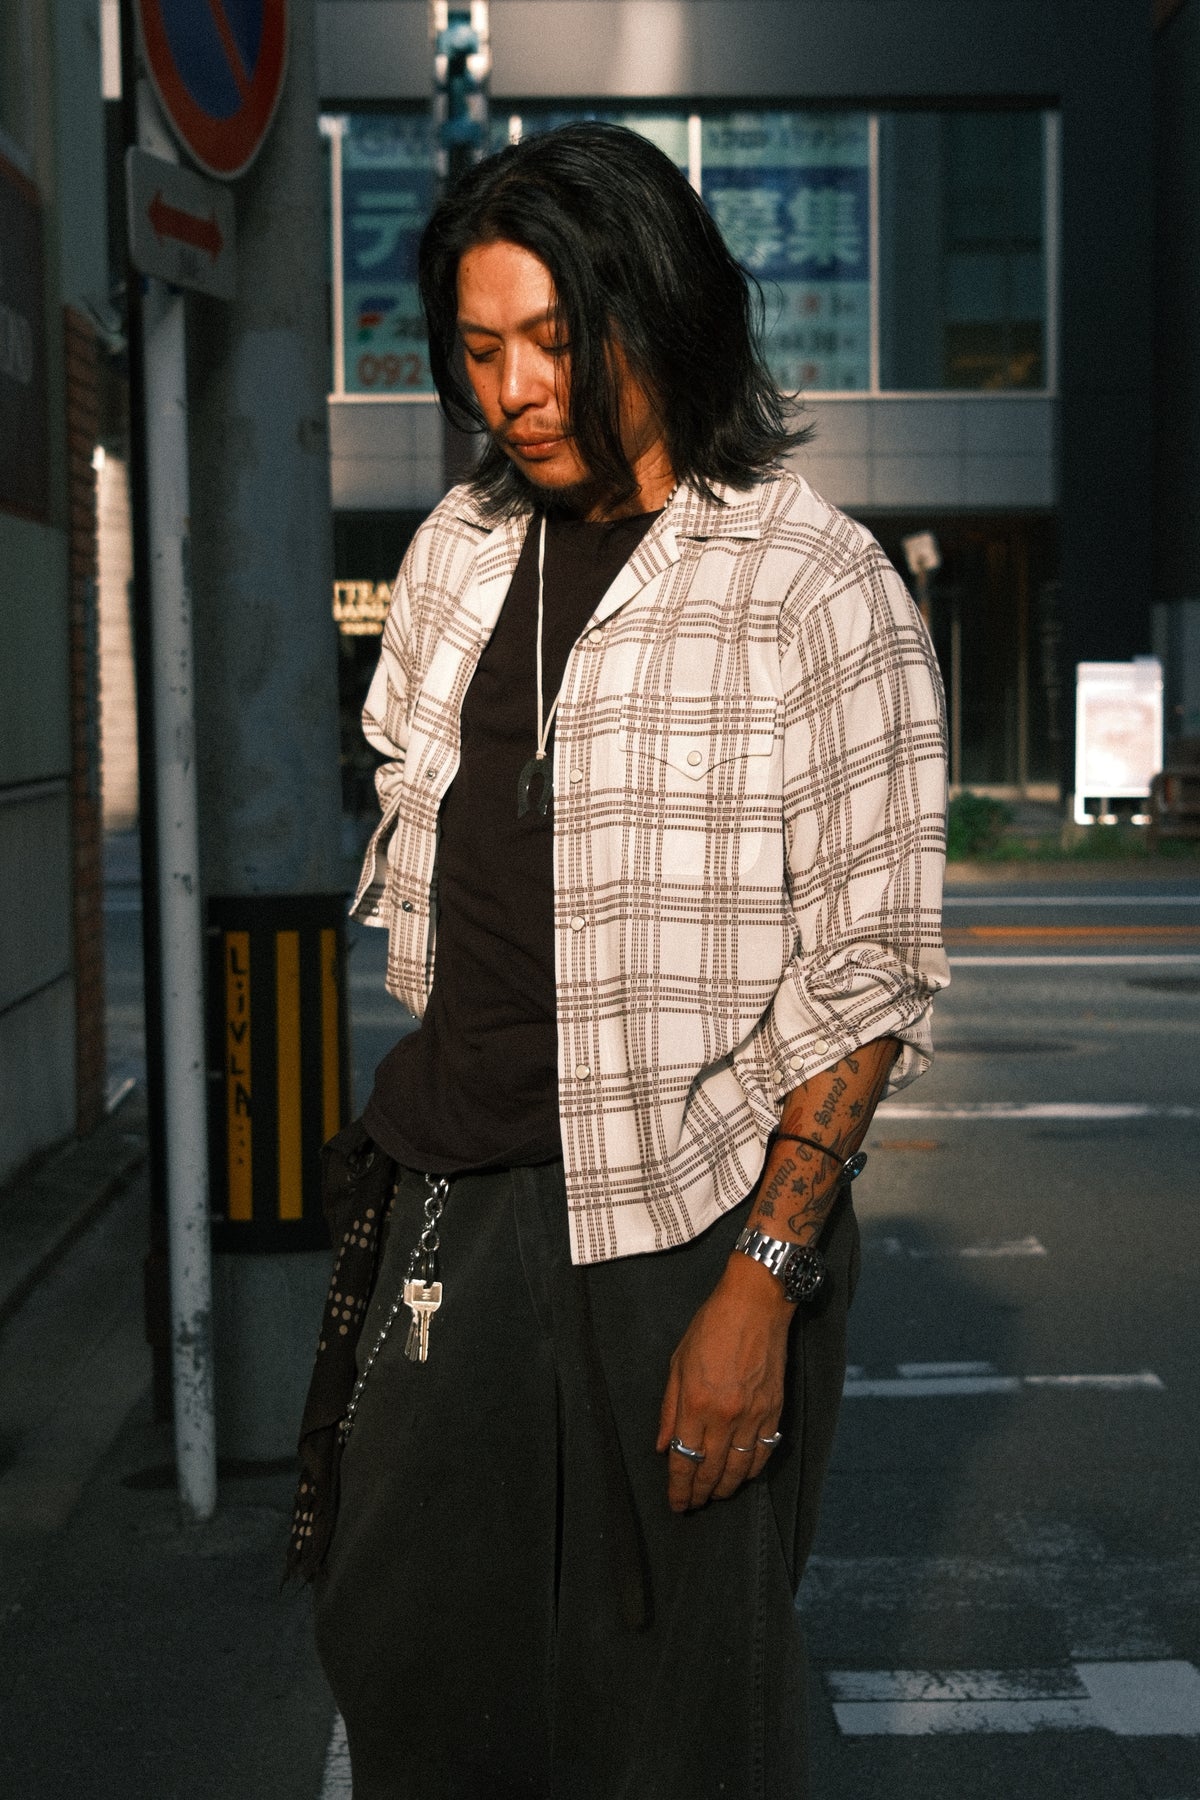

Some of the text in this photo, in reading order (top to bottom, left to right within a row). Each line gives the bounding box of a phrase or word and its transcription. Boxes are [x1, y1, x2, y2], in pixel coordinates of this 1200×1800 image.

[759, 1077, 847, 1218] Beyond Te Speed
